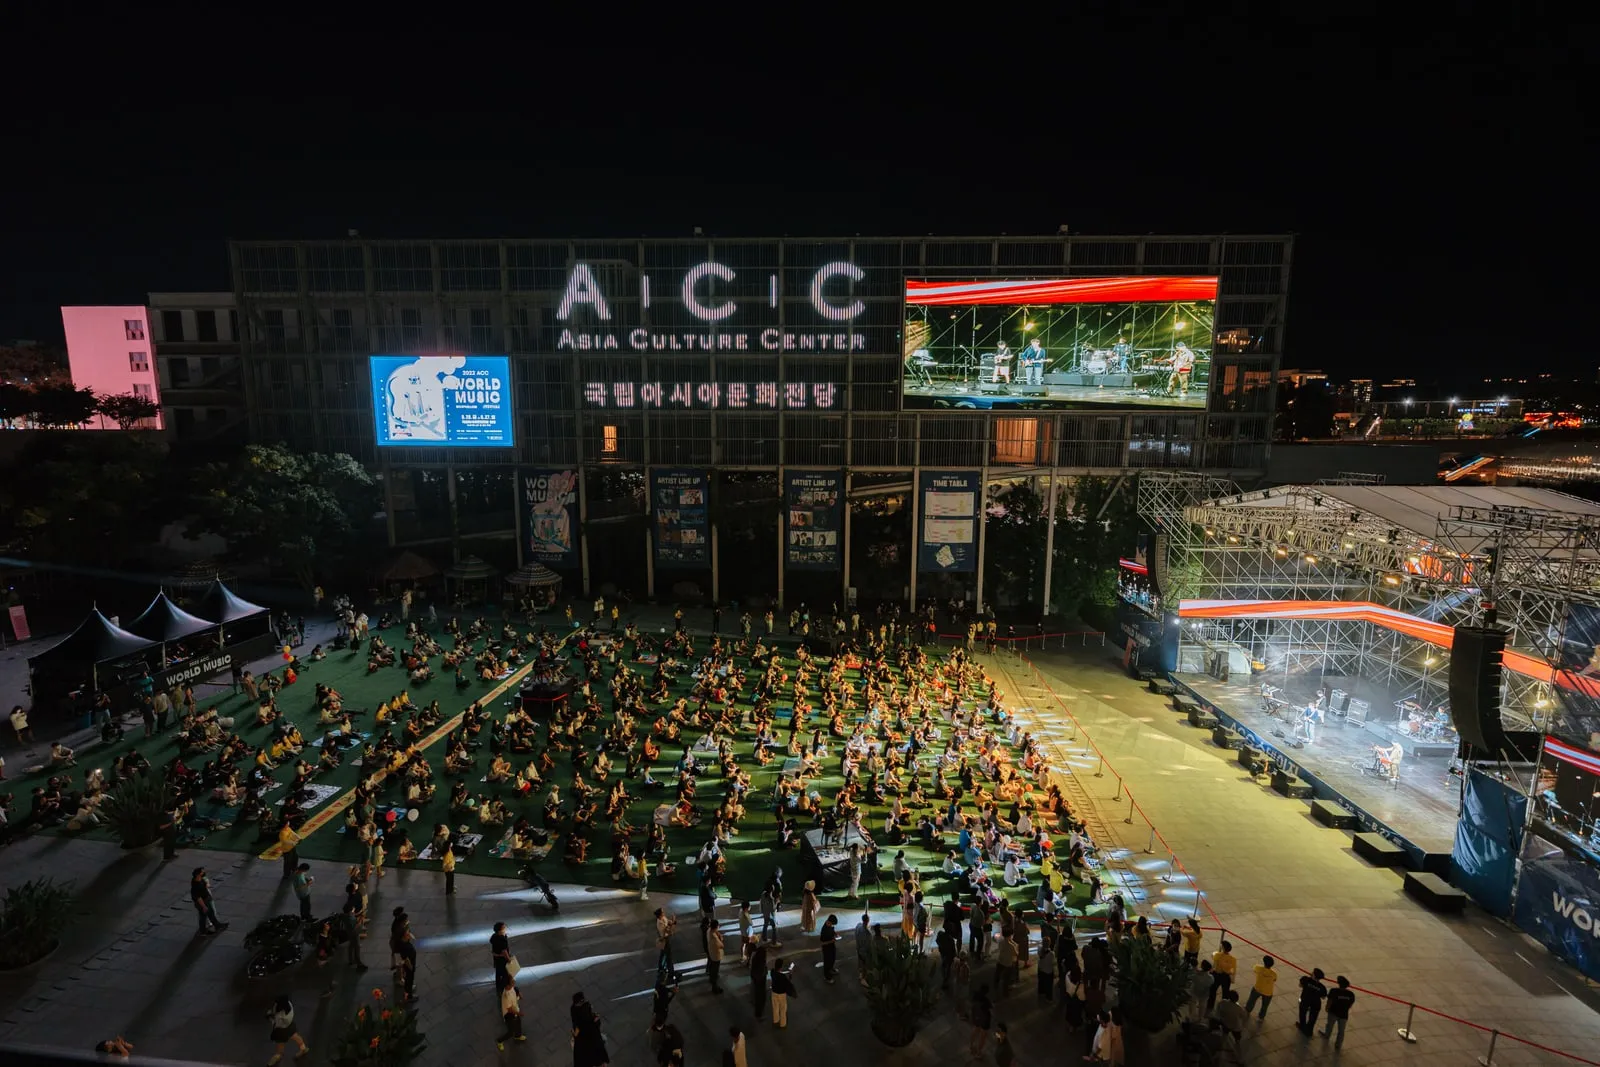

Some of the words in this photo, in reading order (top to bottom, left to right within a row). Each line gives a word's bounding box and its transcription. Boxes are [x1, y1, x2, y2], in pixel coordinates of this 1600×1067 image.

[456, 378, 501, 390] WORLD
[455, 391, 500, 403] MUSIC
[584, 381, 836, 408] 국립아시아문화전당
[933, 479, 947, 487] TIME
[948, 479, 968, 487] TABLE
[166, 665, 201, 686] WORLD
[203, 654, 232, 673] MUSIC
